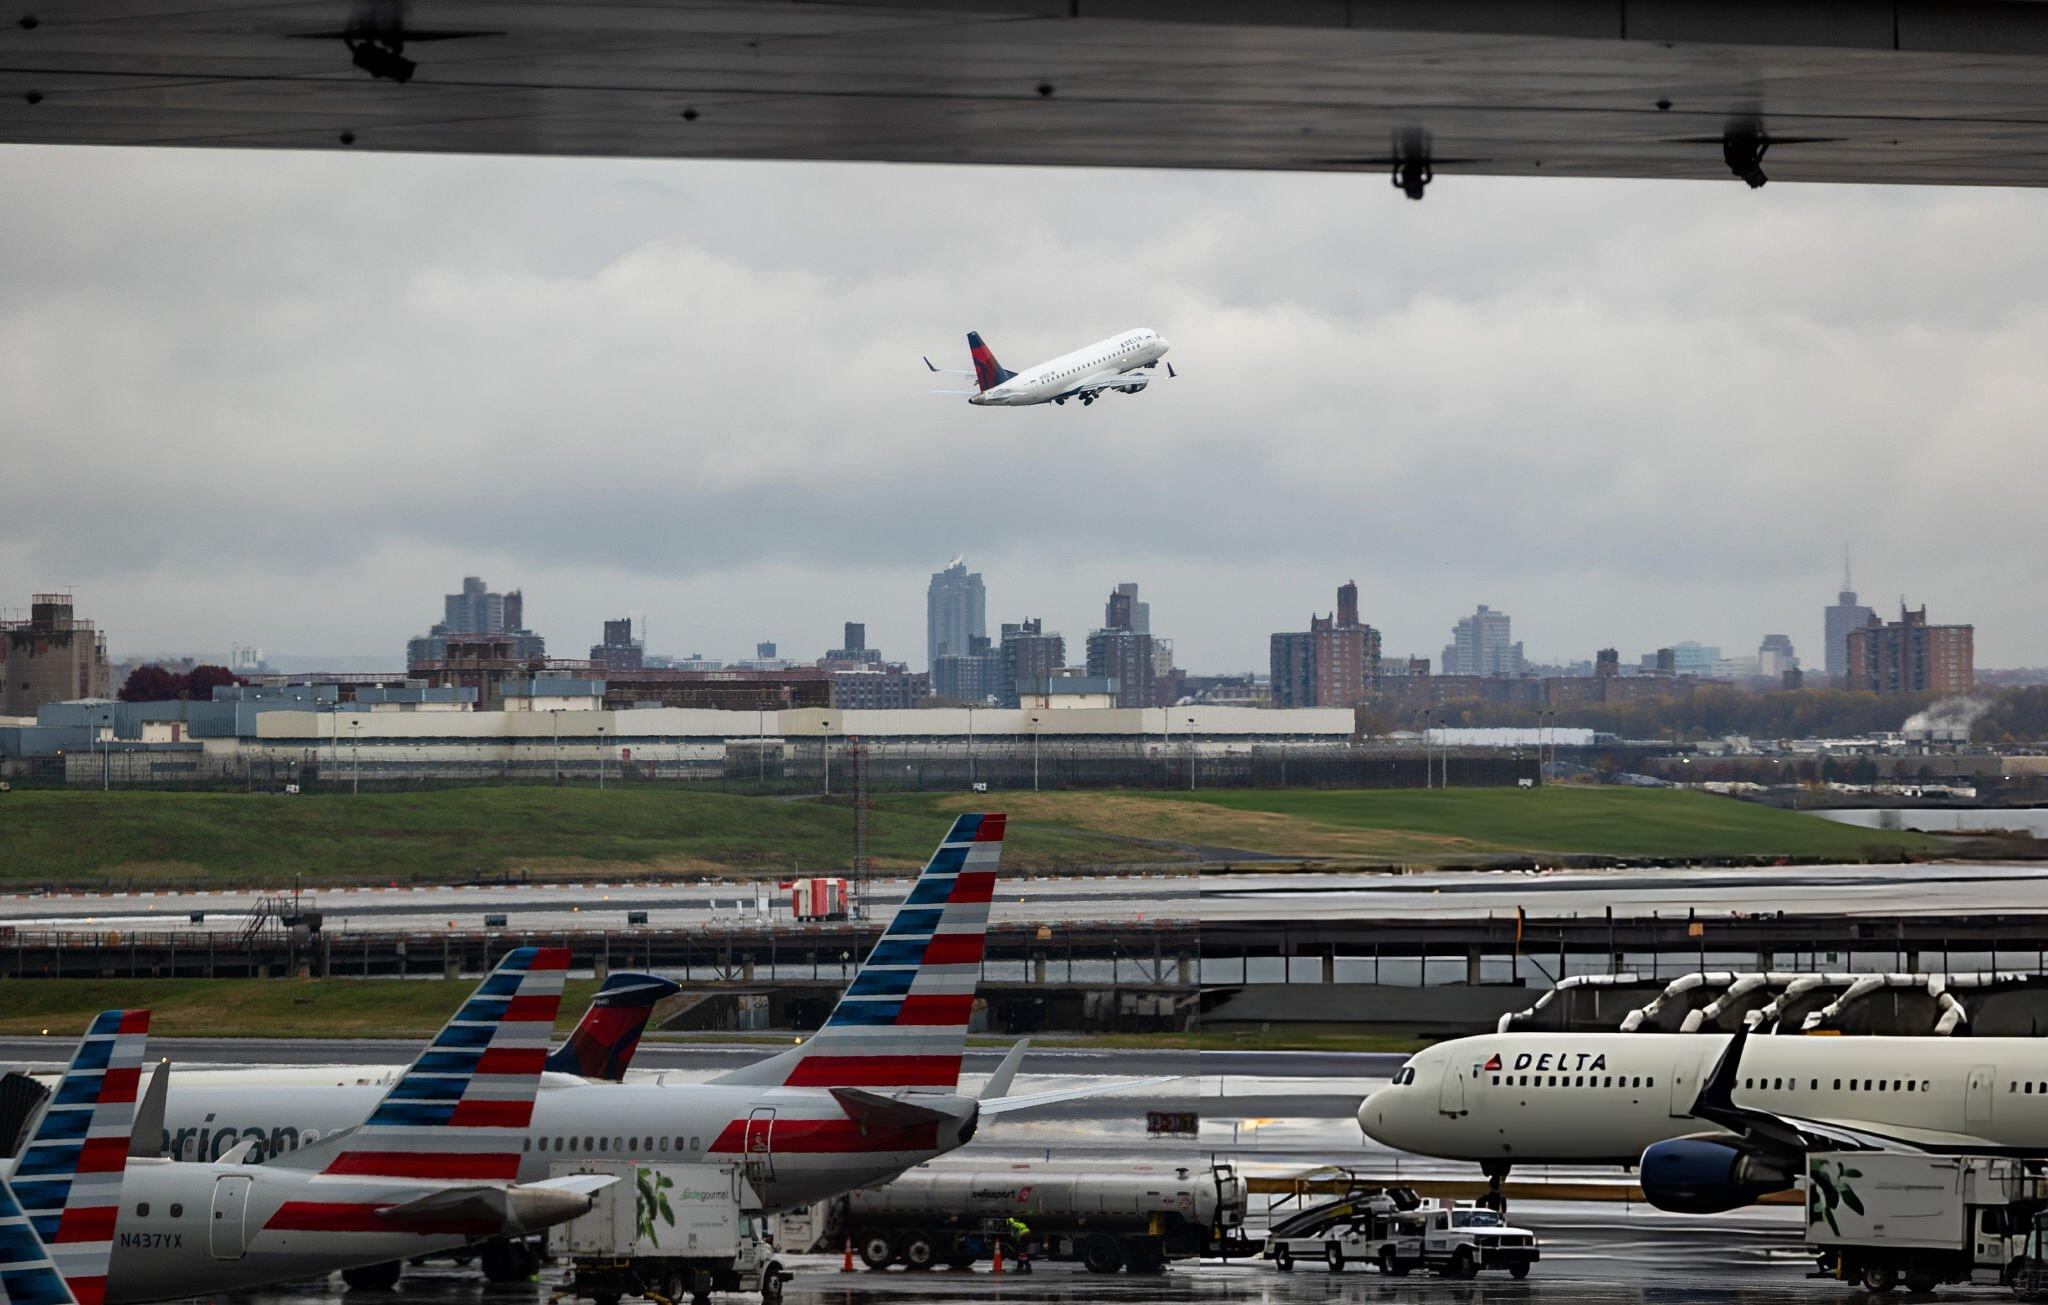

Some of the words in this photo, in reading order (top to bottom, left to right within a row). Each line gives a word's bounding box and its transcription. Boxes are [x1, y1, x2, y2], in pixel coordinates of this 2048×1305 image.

[1124, 336, 1142, 346] DELTA
[1514, 1053, 1606, 1071] DELTA
[162, 1113, 299, 1164] rican
[971, 1189, 1016, 1200] swissport
[120, 1232, 182, 1248] N437YX
